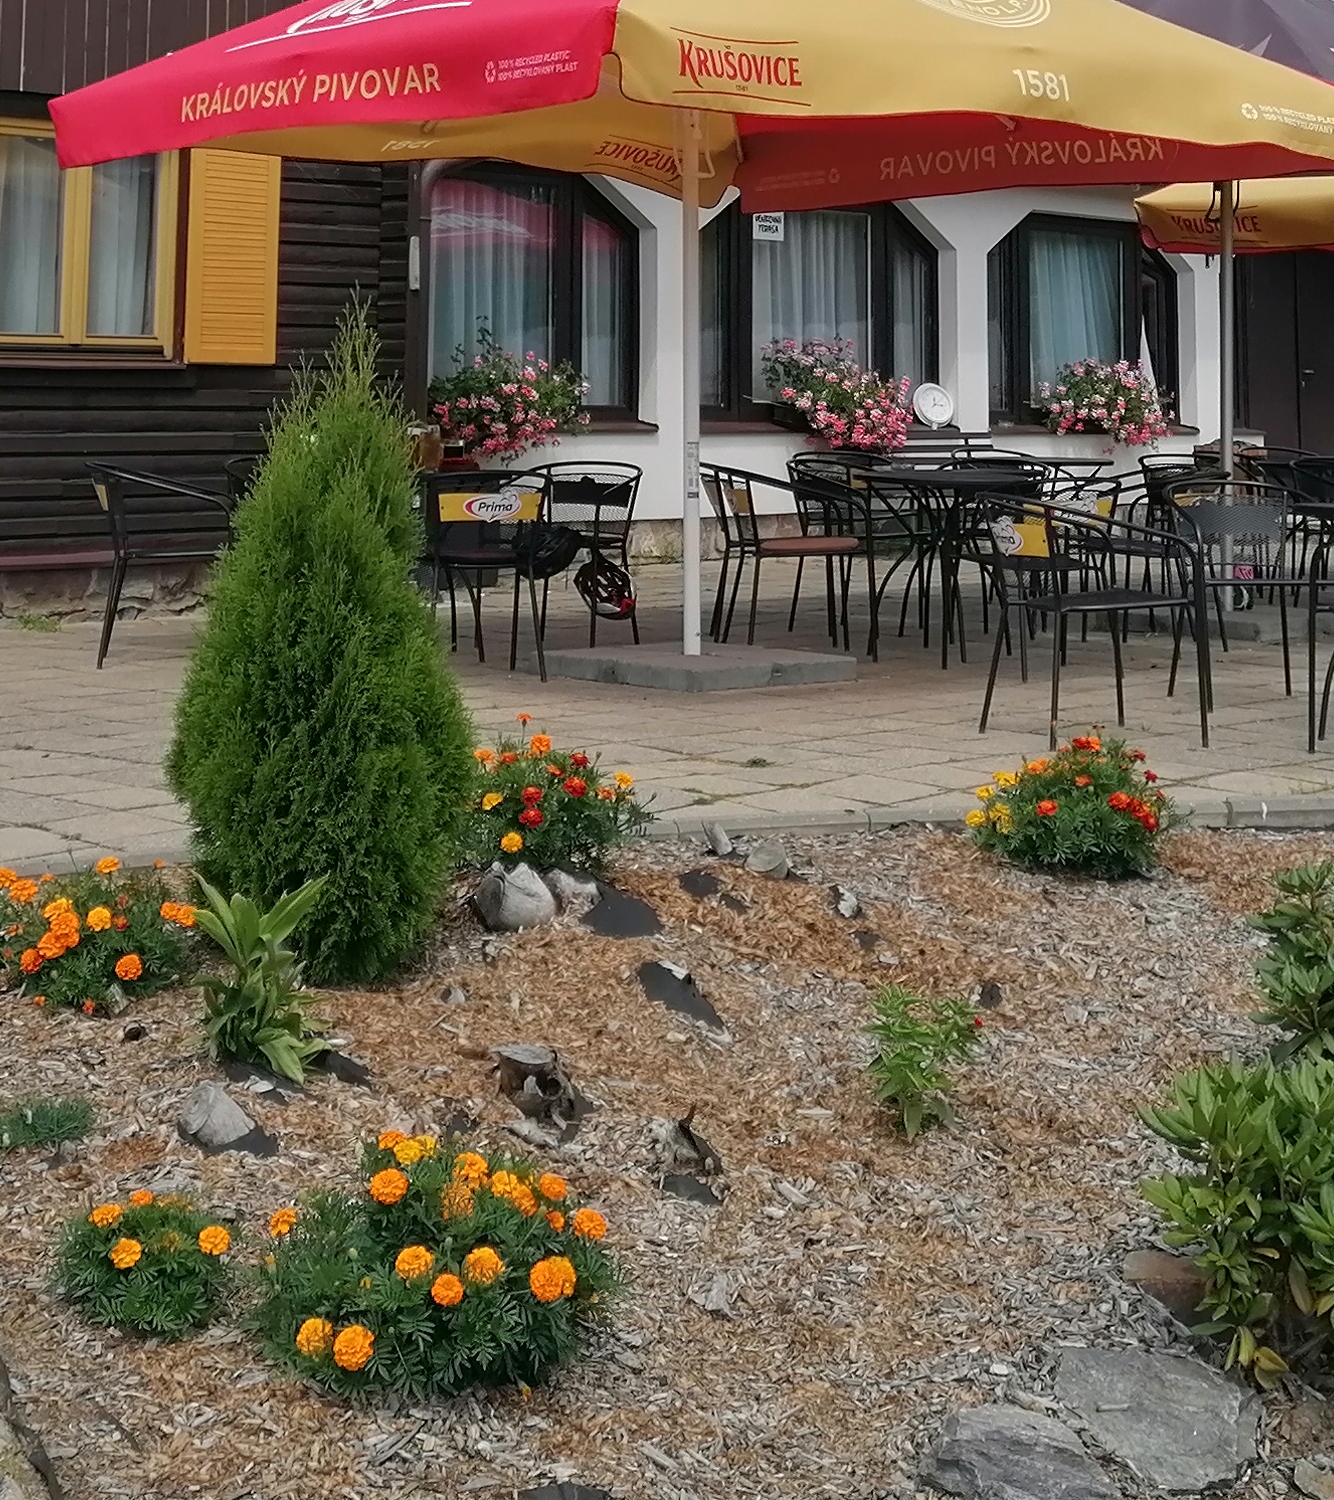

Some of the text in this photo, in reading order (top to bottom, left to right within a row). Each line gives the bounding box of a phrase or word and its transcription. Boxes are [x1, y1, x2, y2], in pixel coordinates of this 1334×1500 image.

[677, 38, 802, 89] KRUŠOVICE
[180, 63, 441, 123] KRÁLOVSKÝ PIVOVAR
[1012, 68, 1069, 102] 1581
[478, 501, 513, 512] Prima
